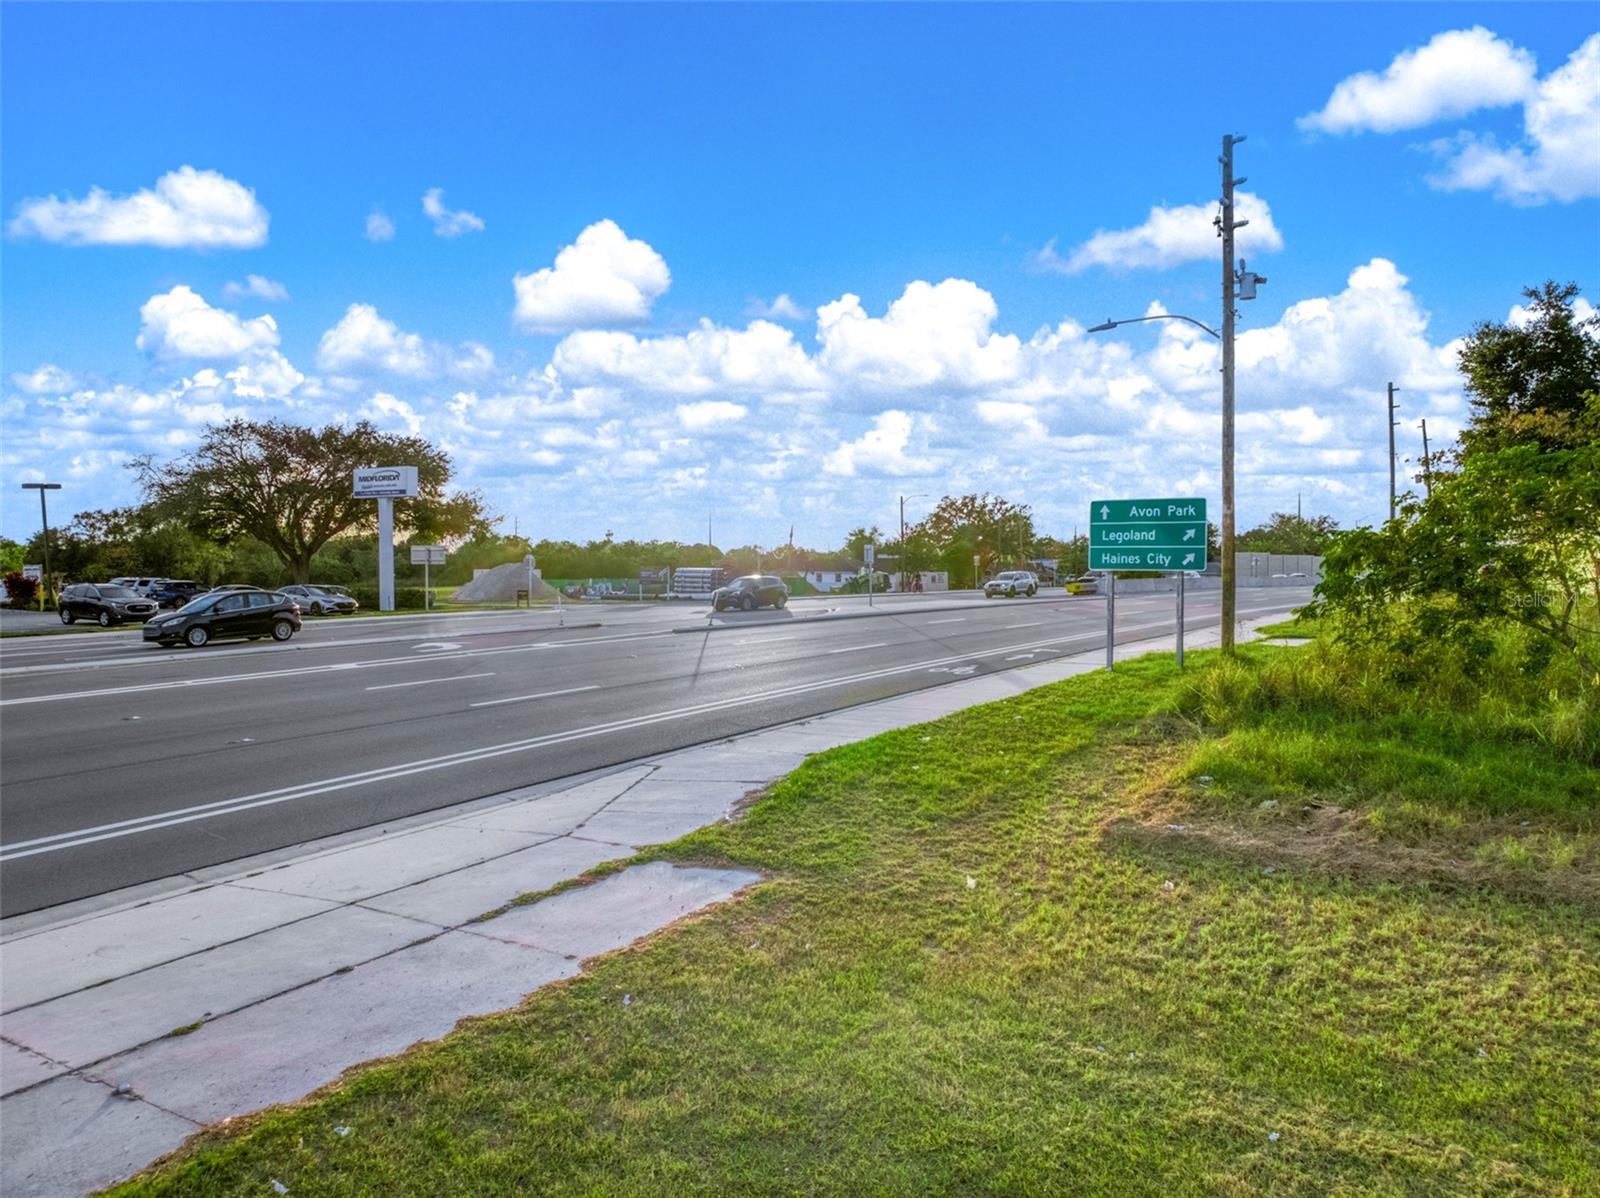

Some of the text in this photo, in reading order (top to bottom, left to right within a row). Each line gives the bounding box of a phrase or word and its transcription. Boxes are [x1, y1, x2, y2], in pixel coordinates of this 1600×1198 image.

[358, 474, 400, 482] MIDFLORIDA
[1129, 505, 1196, 517] Avon Park
[1102, 529, 1156, 544] Legoland
[1101, 553, 1172, 567] Haines City
